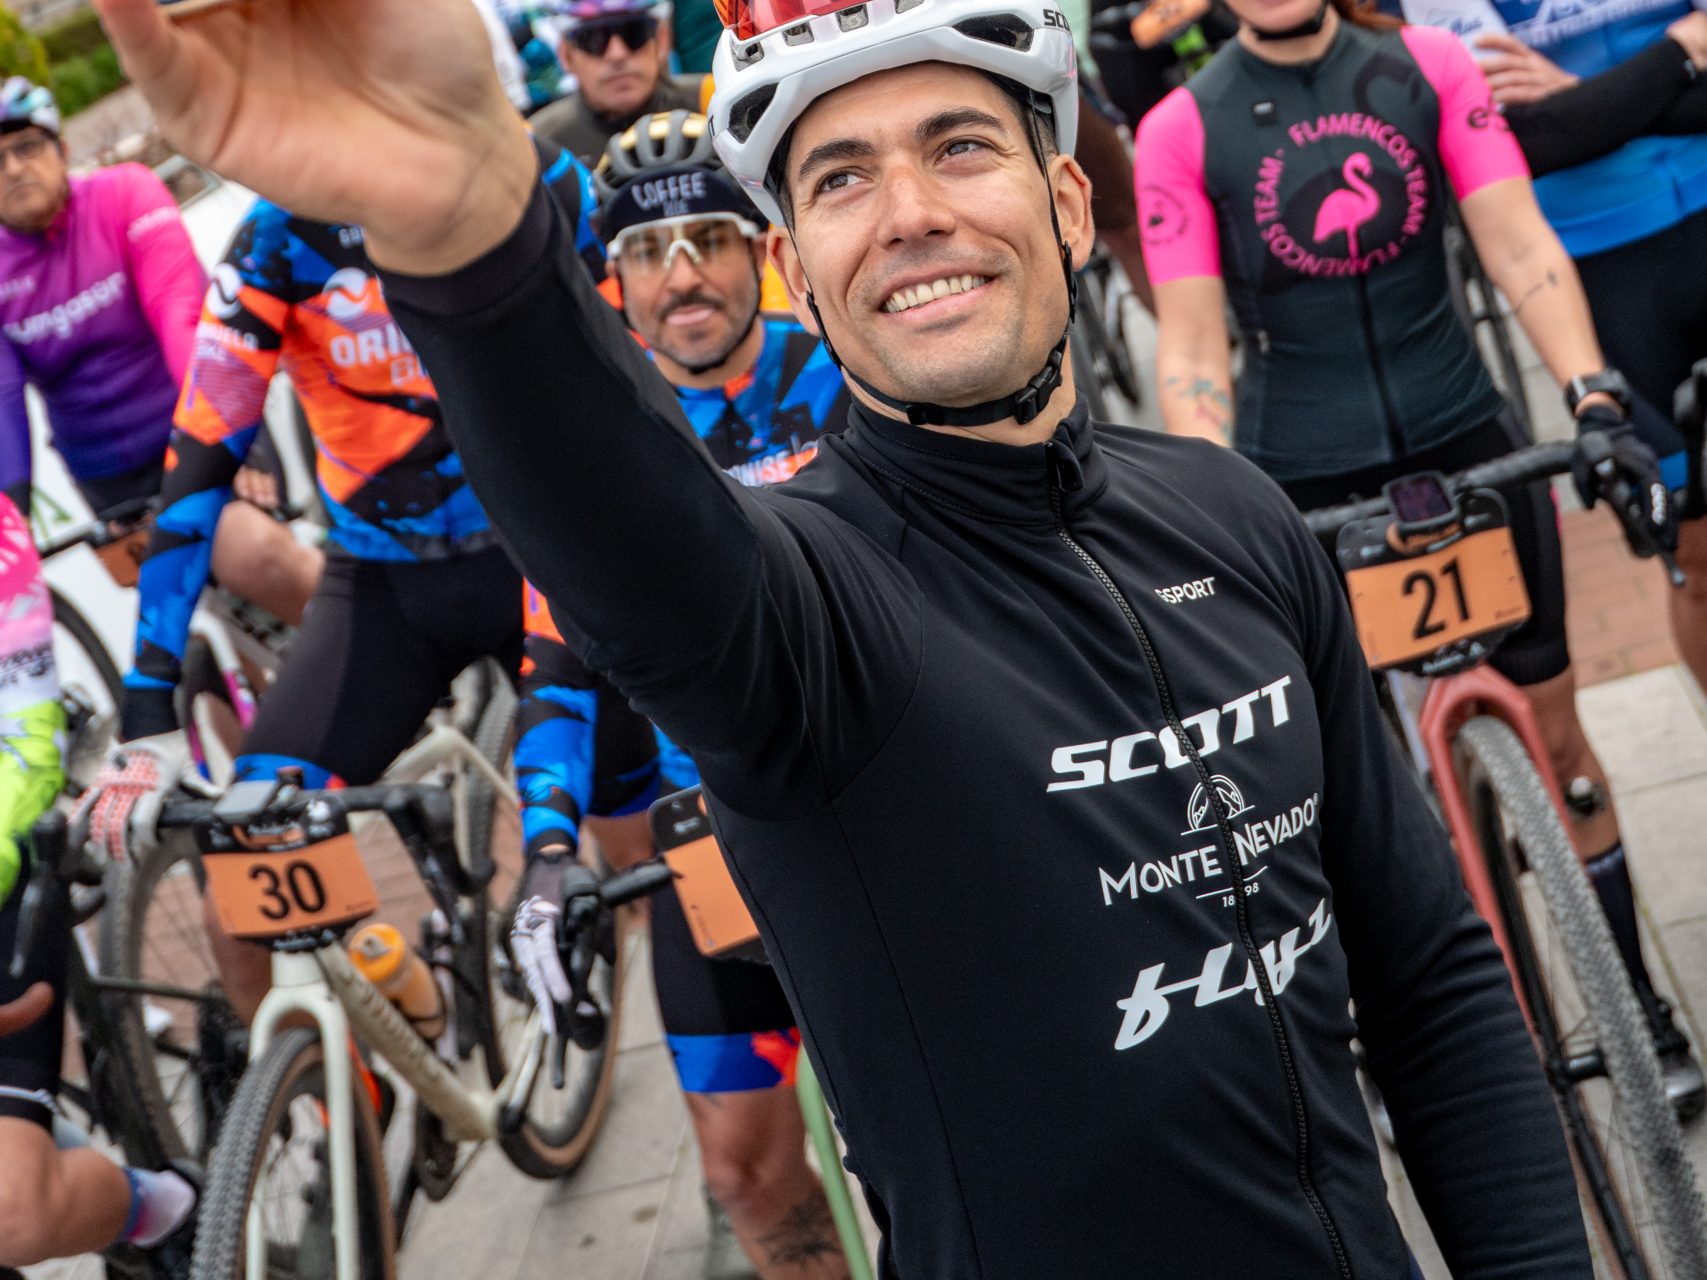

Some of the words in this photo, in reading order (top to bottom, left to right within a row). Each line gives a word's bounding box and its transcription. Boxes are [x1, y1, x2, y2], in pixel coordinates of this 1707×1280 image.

[1287, 112, 1418, 170] FLAMENCOS
[631, 171, 706, 211] COFFEE
[1402, 554, 1471, 640] 21
[1046, 675, 1292, 793] SCOTT
[1099, 845, 1223, 906] MONTE
[1231, 798, 1315, 866] NEVADO
[249, 860, 327, 921] 30
